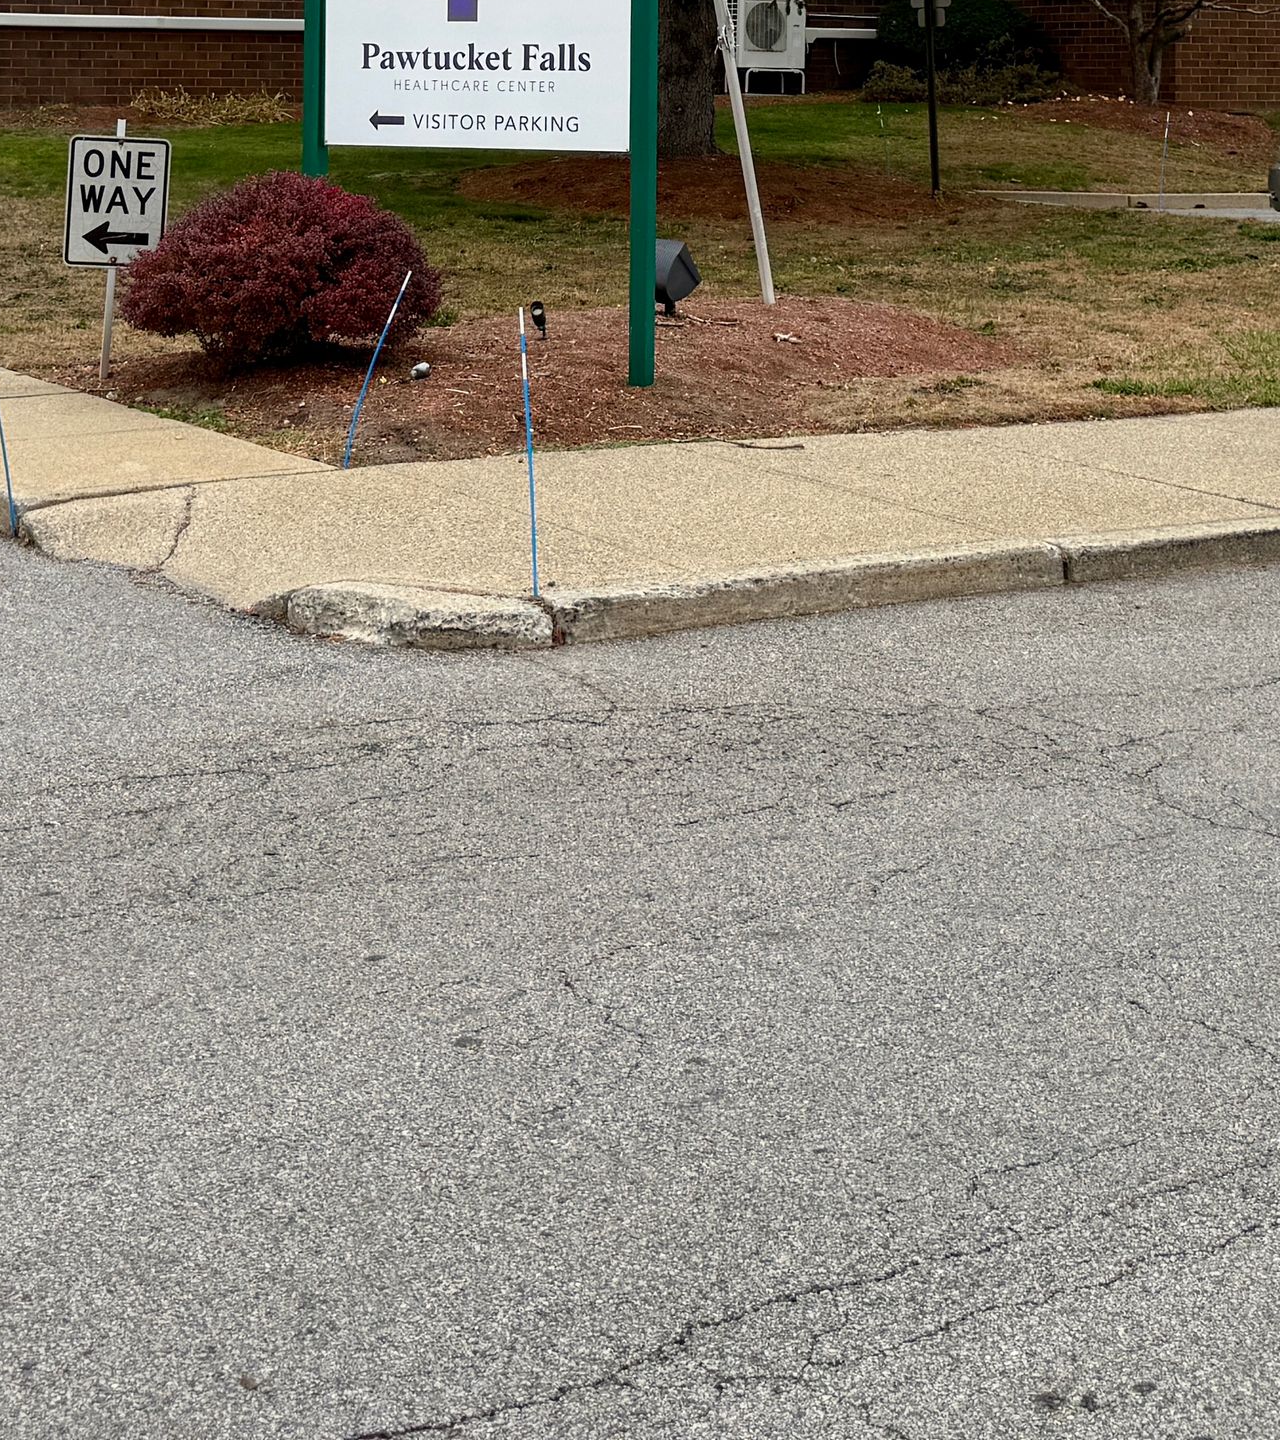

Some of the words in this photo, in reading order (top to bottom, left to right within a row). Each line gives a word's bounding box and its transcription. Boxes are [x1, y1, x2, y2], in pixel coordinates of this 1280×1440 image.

[361, 43, 513, 71] Pawtucket
[521, 43, 591, 72] Falls
[393, 79, 489, 92] HEALTHCARE
[497, 80, 555, 93] CENTER
[413, 113, 486, 131] VISITOR
[494, 115, 580, 133] PARKING
[83, 149, 156, 180] ONE
[80, 184, 156, 216] WAY
